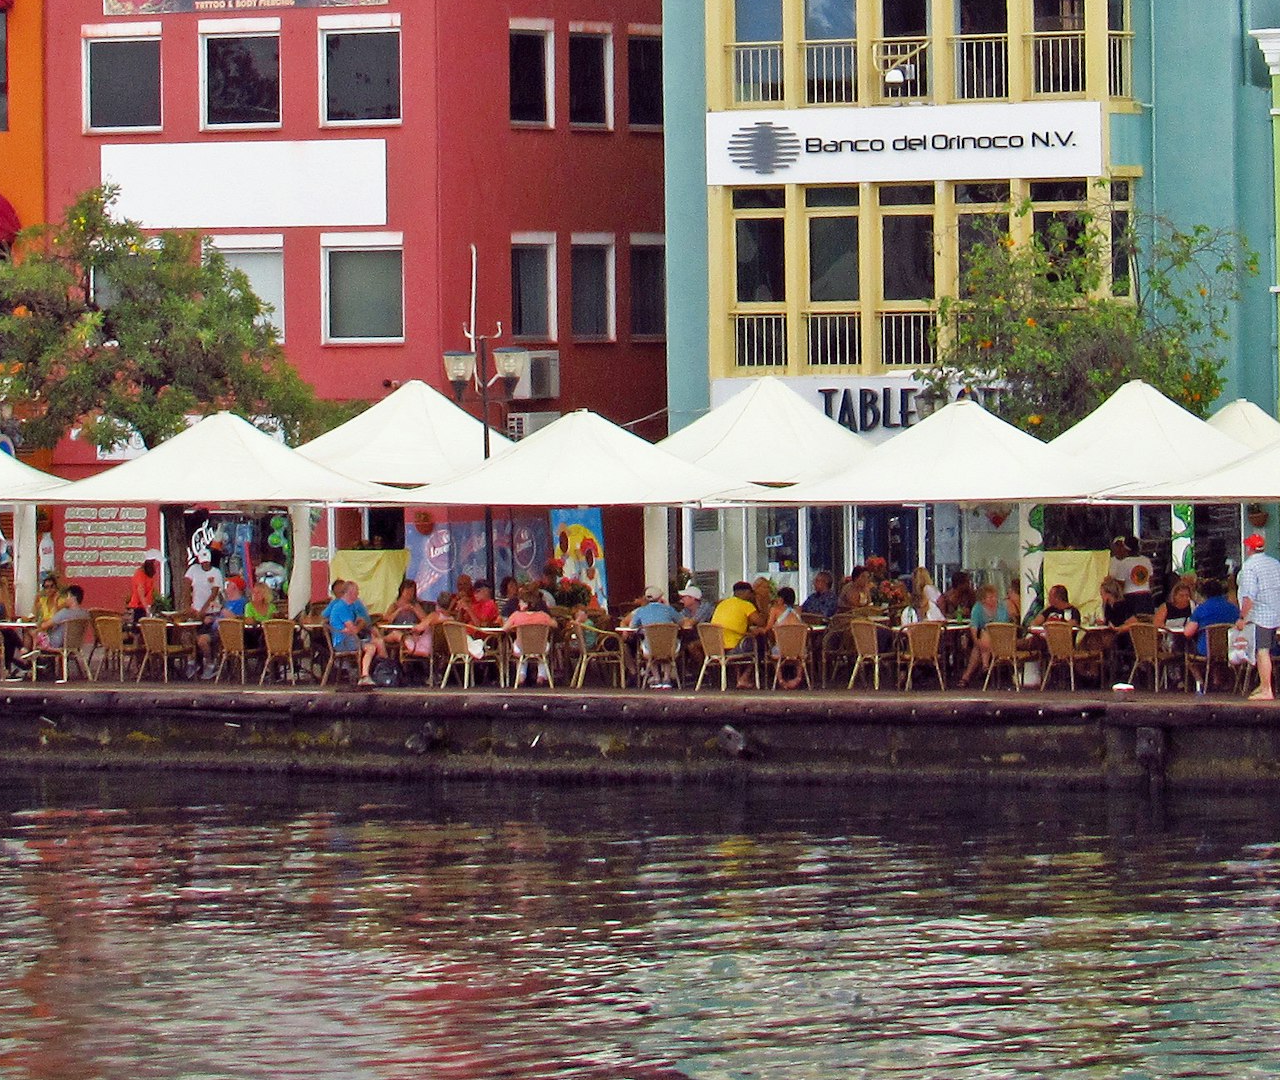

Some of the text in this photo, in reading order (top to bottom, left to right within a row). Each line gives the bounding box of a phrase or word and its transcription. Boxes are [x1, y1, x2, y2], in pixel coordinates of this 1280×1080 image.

[195, 1, 226, 9] TATTOO
[236, 0, 257, 7] BODY
[805, 130, 1077, 153] Banco del Orinoco N.V.
